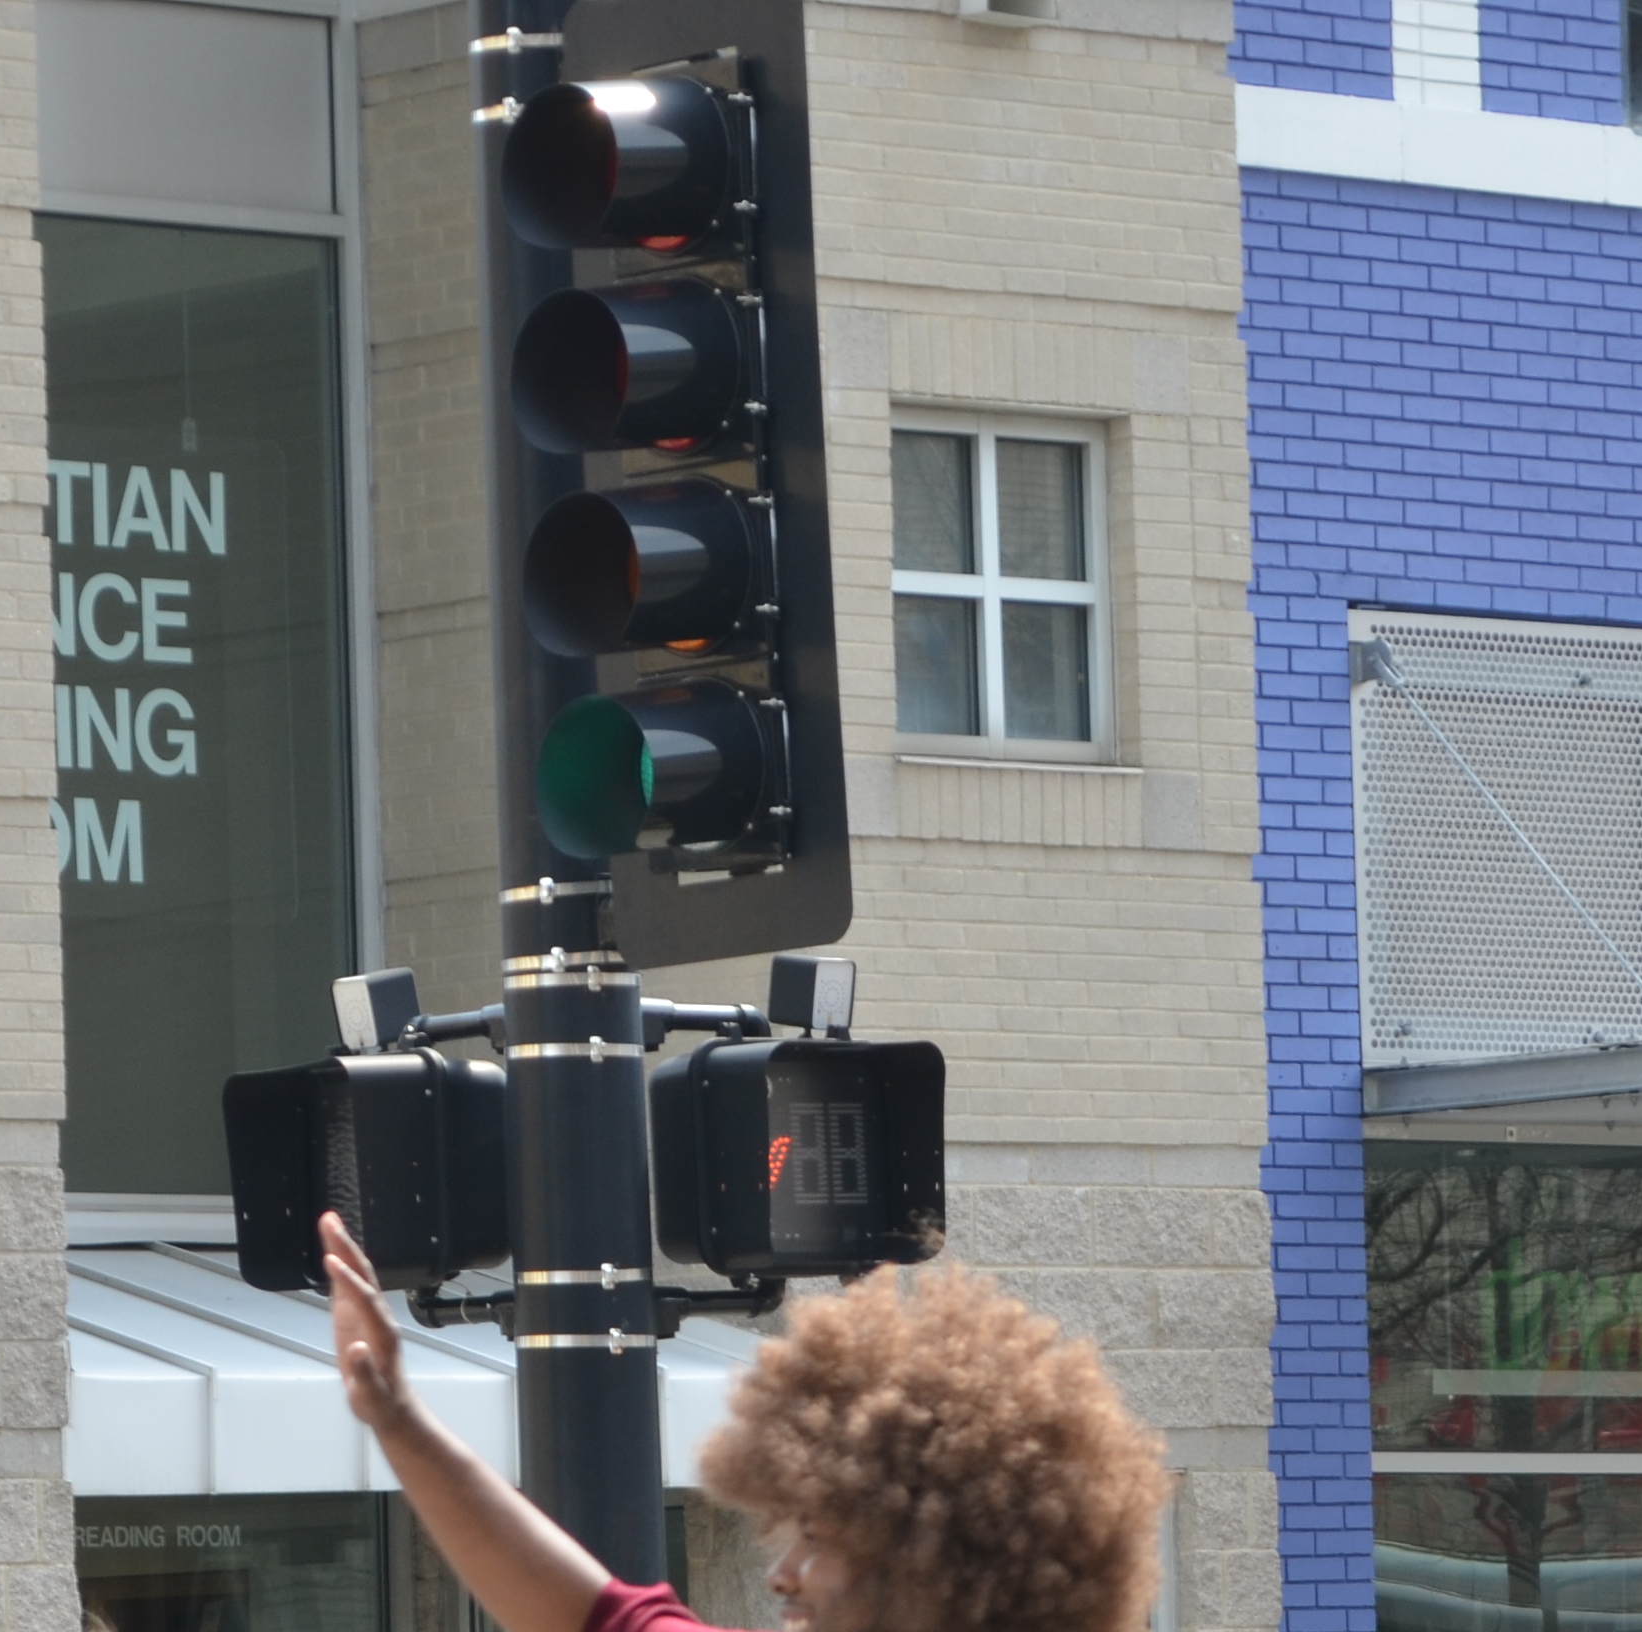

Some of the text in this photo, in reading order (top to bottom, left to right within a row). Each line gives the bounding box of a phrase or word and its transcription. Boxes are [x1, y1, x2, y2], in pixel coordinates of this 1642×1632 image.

[48, 459, 227, 556] TIAN
[51, 797, 144, 884] M
[75, 1525, 242, 1548] READING ROOM
